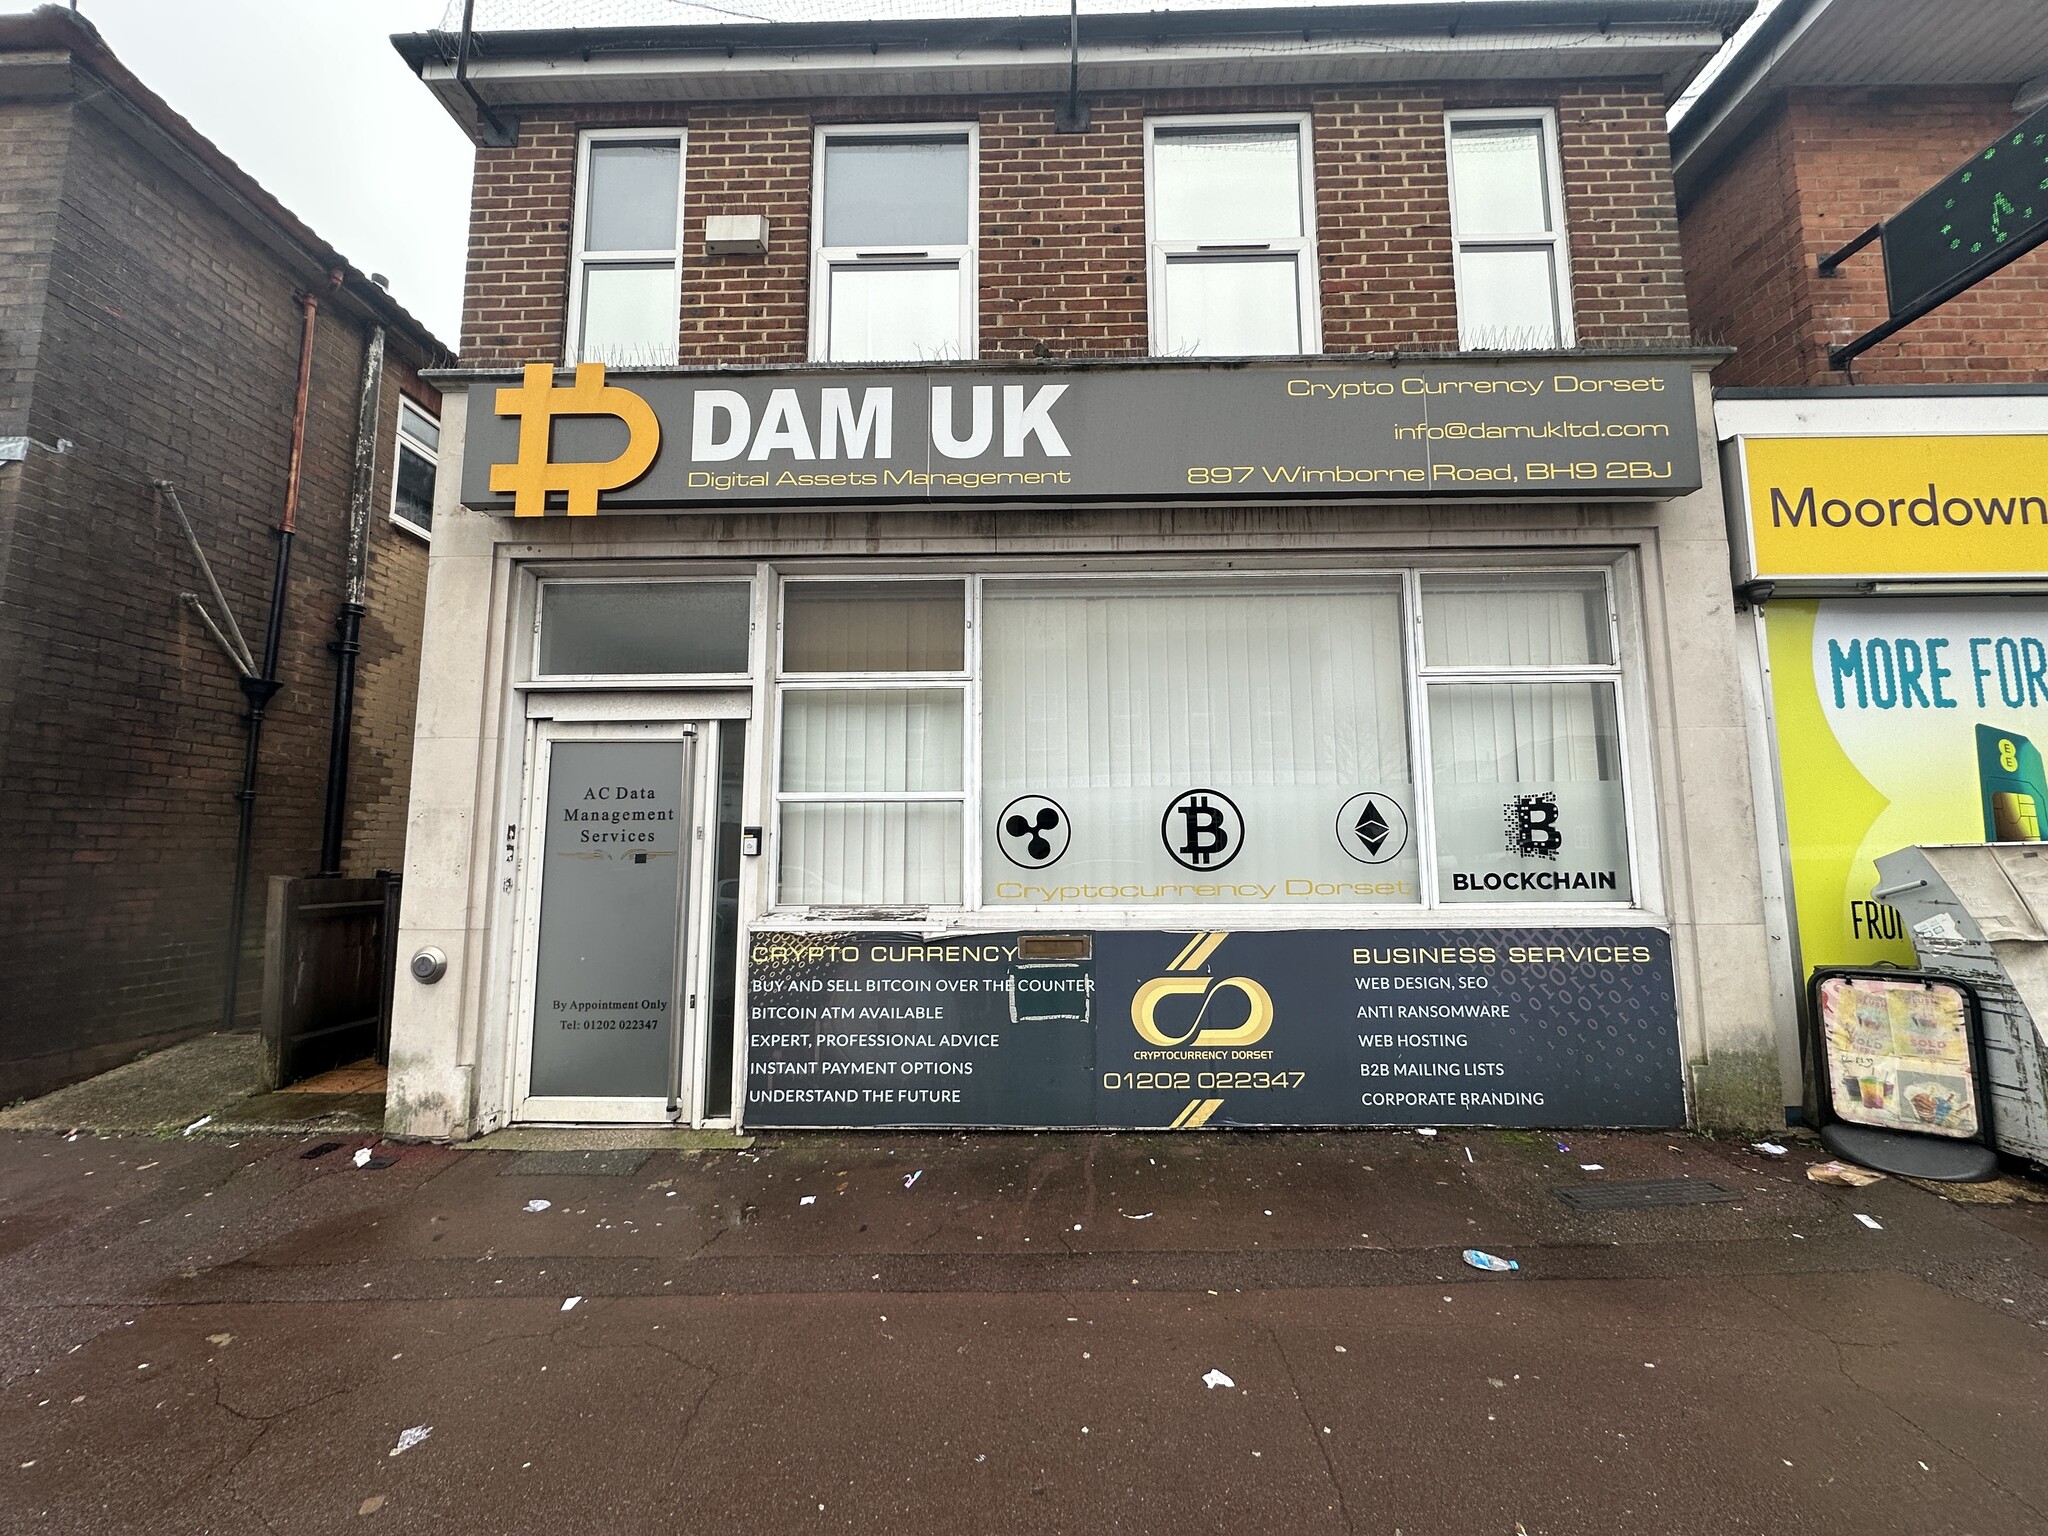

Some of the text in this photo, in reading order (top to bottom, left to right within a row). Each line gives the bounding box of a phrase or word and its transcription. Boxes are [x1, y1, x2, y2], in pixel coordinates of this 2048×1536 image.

[1287, 375, 1665, 399] Crypto Currency Dorset
[690, 383, 1072, 462] DAM UK
[1394, 420, 1670, 441] info@damukltd.com
[688, 468, 1072, 491] Digital Assets Management
[1187, 461, 1672, 485] 897 Wimborne Road, BH9 2BJ
[1769, 483, 2048, 528] Moordown
[1828, 636, 2048, 709] MORE FOR
[616, 786, 656, 800] Data
[563, 808, 674, 824] Management
[580, 829, 655, 843] Services
[1452, 871, 1617, 891] BLOCKCHAIN
[996, 878, 1413, 901] Cryptocurrency Dorset
[1851, 900, 1903, 939] FRO
[752, 946, 1019, 962] CRYPTO CURRENCY
[1353, 946, 1651, 964] BUSINESS SERVICES
[752, 979, 1096, 993] BUY AND SELL BITCOIN OVER THE COUNTER
[1355, 976, 1489, 991] WEB DESIGN, SEO
[553, 999, 668, 1012] By Appointment Only
[1356, 1005, 1510, 1019] ANTI RANSOMWARE
[751, 1007, 944, 1020] BITCOIN ATM AVAILABLE
[560, 1020, 658, 1030] Tel: 01202 022347
[750, 1034, 1000, 1049] EXPERT, PROFESSIONAL ADVICE
[1358, 1034, 1468, 1047] WEB HOSTING
[1133, 1050, 1274, 1061] CRYPTOCURRENCY DORSET
[750, 1061, 974, 1075] INSTANT PAYMENT OPTIONS
[1360, 1062, 1505, 1076] B2B MAILING LISTS
[1103, 1071, 1306, 1089] 01202 022347
[749, 1089, 961, 1103] UNDERSTAND THE FUTURE
[1361, 1092, 1545, 1106] CORPORATE BRANDING
